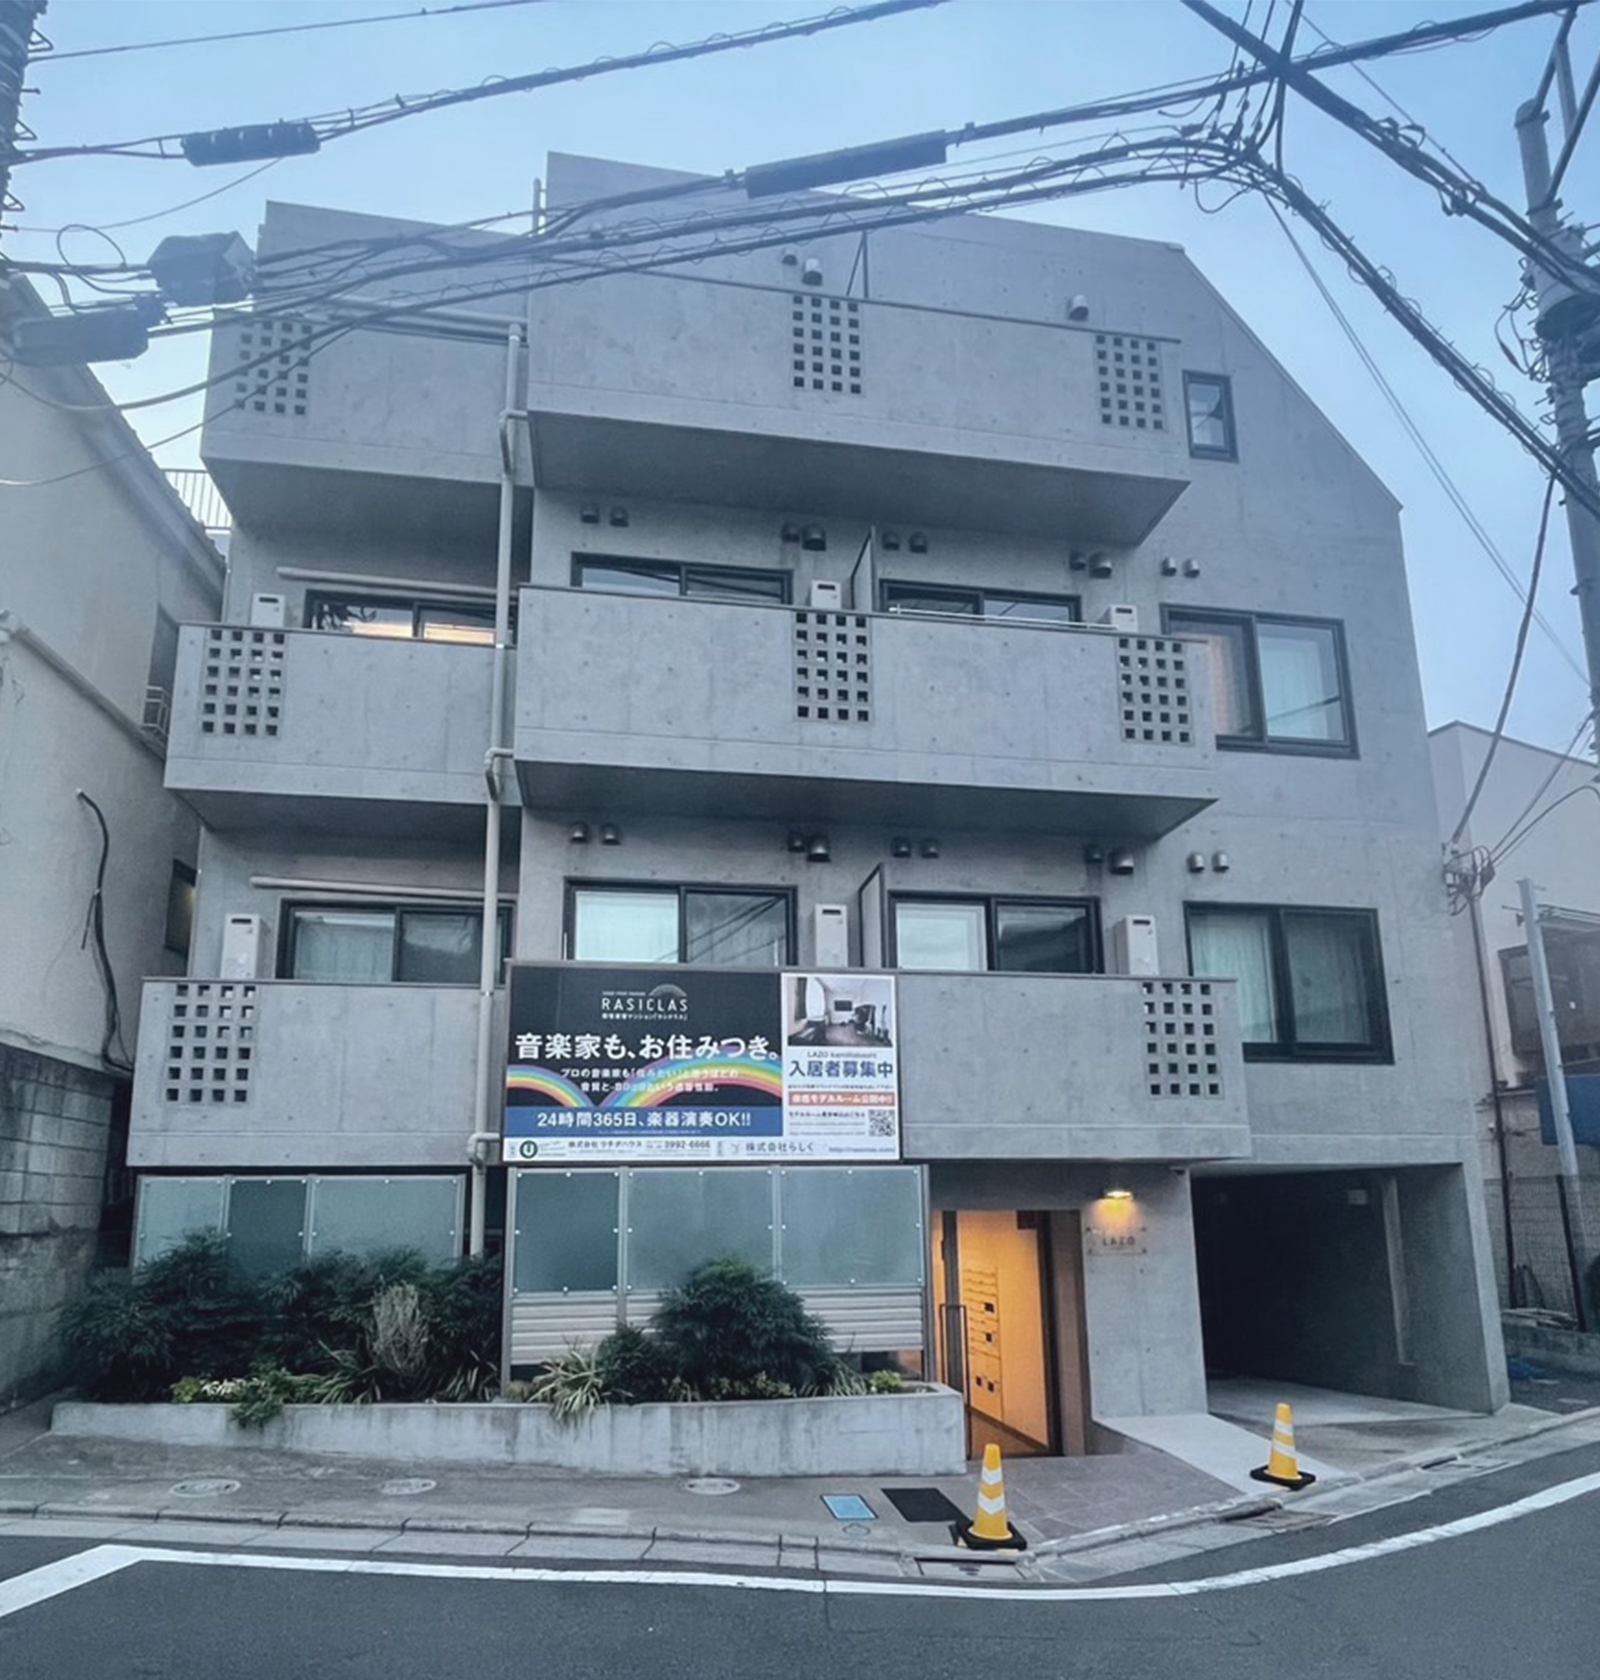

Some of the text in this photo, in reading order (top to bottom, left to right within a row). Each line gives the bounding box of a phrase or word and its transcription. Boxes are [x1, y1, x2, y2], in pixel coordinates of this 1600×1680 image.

[602, 997, 688, 1012] RASICLAS
[515, 1032, 779, 1061] 音楽家も、お住みつき。
[789, 1060, 893, 1078] 入居者募集中
[537, 1111, 752, 1128] 24時間365日、楽器演奏OK!!
[1103, 1236, 1136, 1246] LAZO
